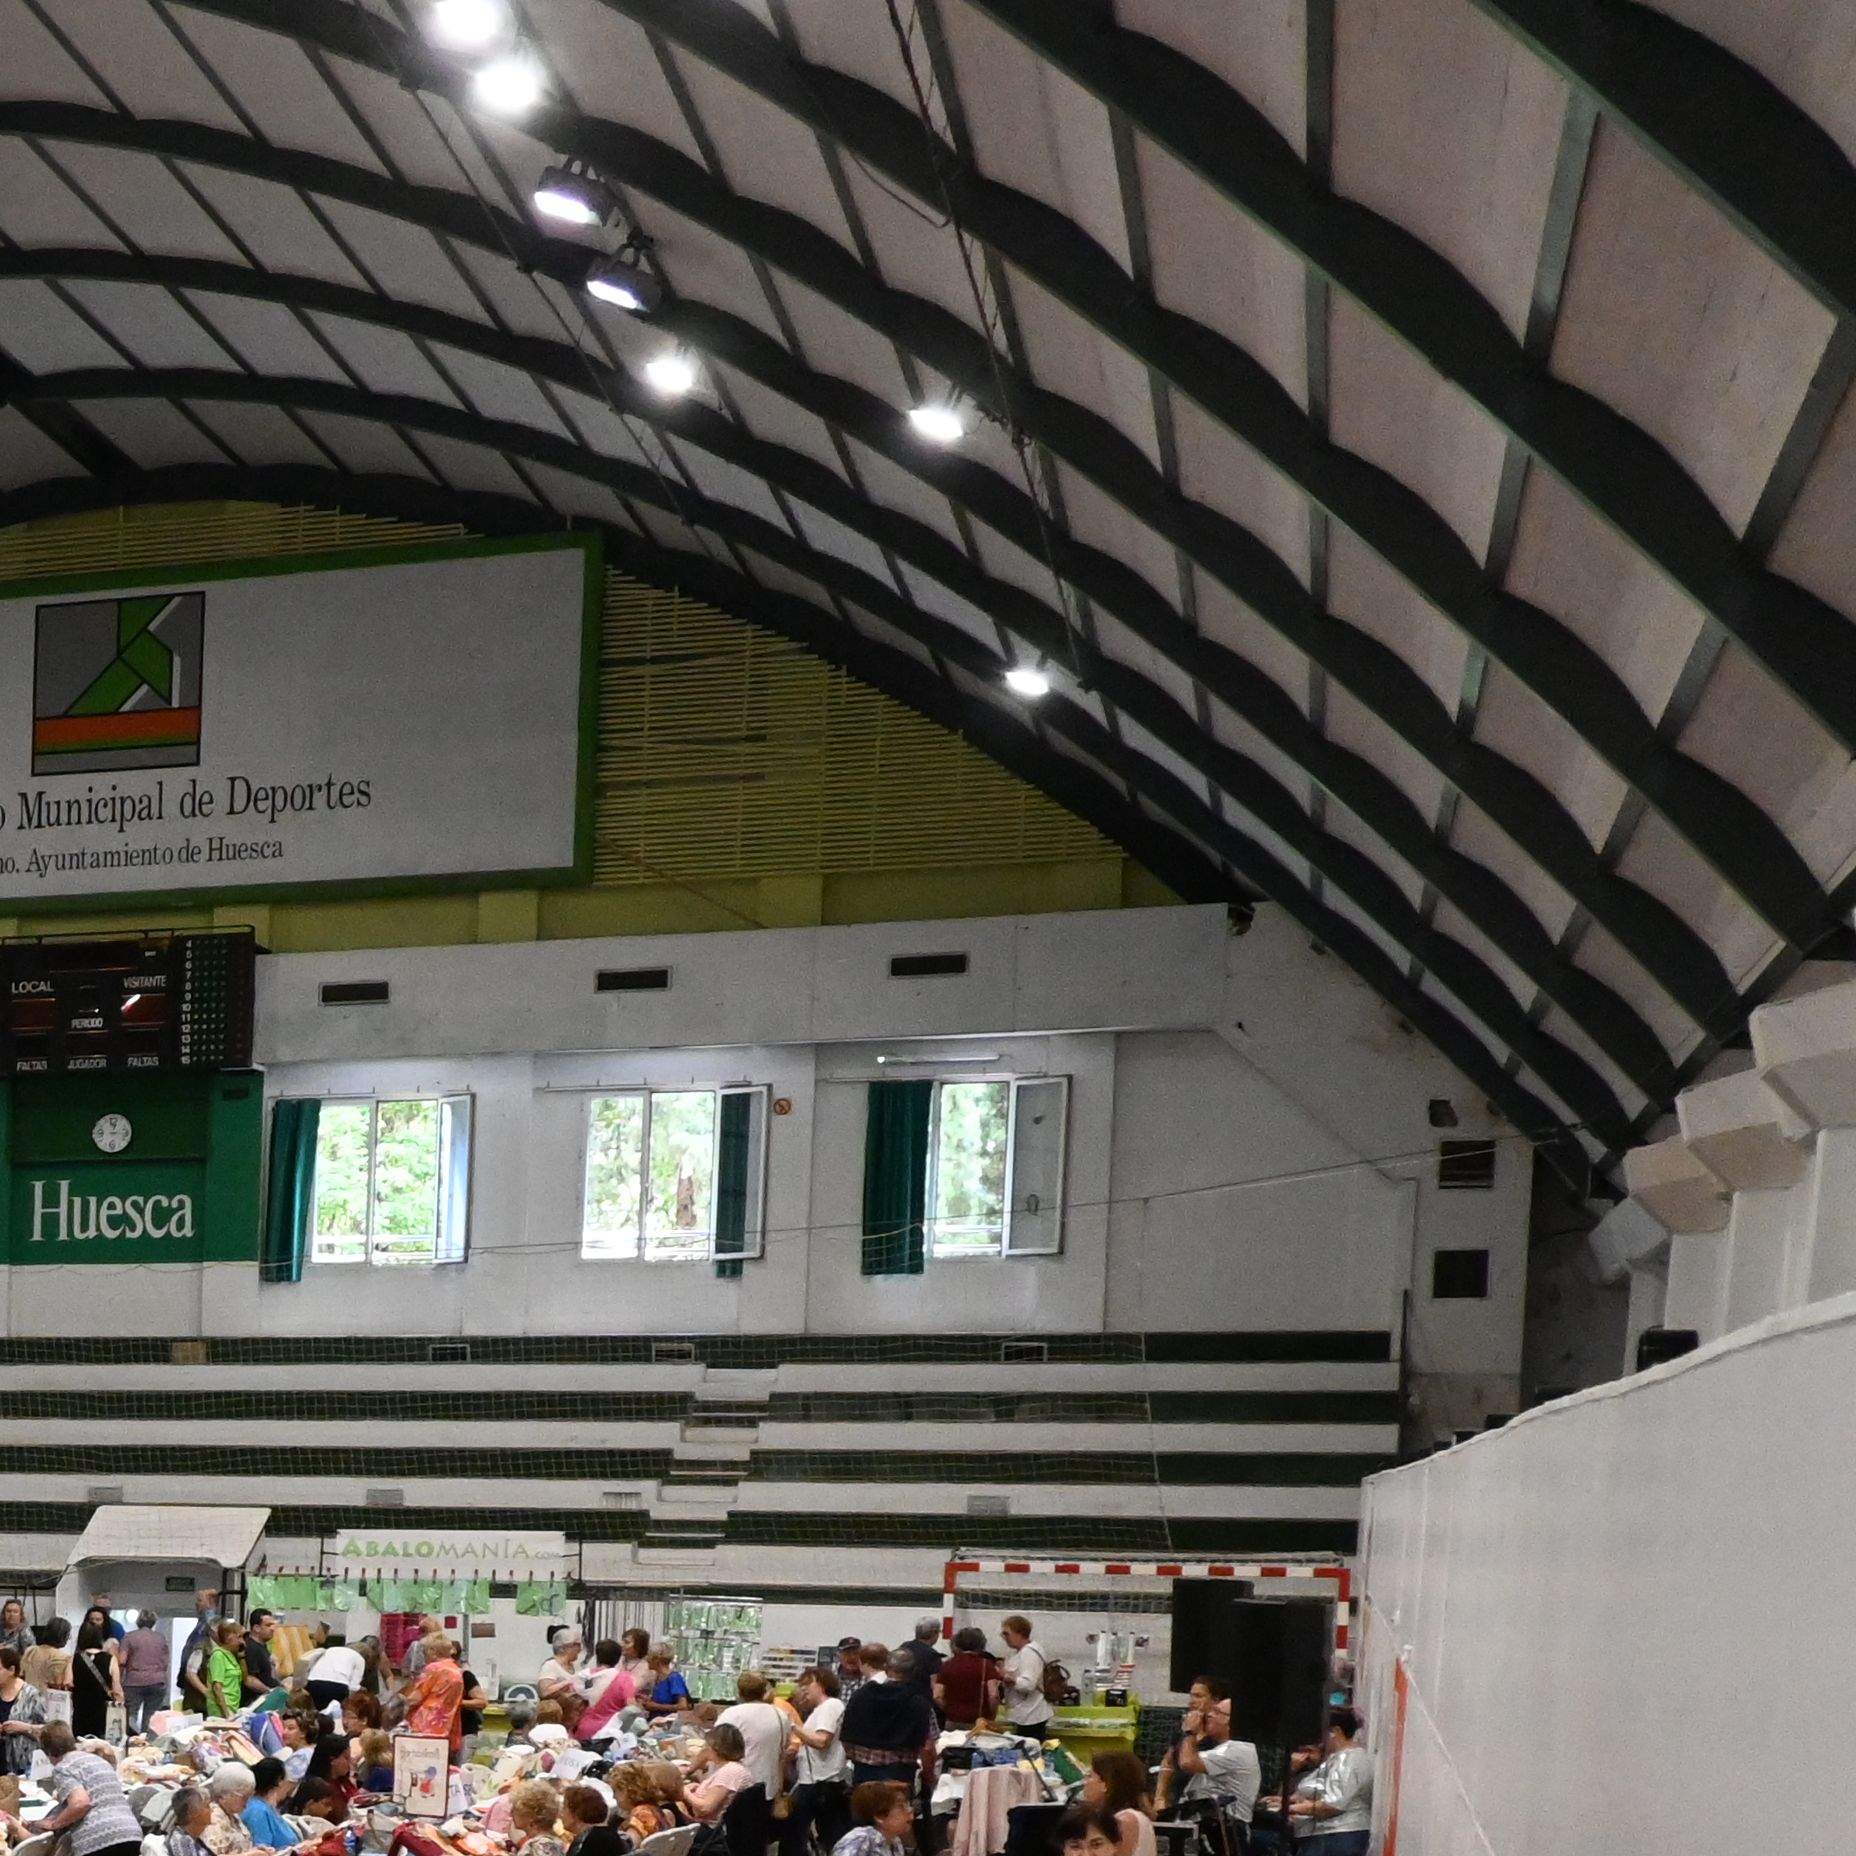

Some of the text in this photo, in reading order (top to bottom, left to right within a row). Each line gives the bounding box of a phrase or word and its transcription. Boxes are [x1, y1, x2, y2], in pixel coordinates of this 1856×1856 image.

[17, 781, 164, 833] Municipal
[179, 778, 214, 819] de
[226, 773, 372, 825] Deportes
[25, 841, 174, 878] Ayuntamiento
[177, 839, 202, 864] de
[206, 835, 283, 862] Huesca
[11, 980, 55, 994] LOCAL
[123, 975, 167, 989] VISITANTE
[16, 1061, 48, 1071] FALTAS
[67, 1059, 107, 1070] JUGADOR
[128, 1056, 159, 1067] FALTAS
[29, 1179, 195, 1242] Huesca
